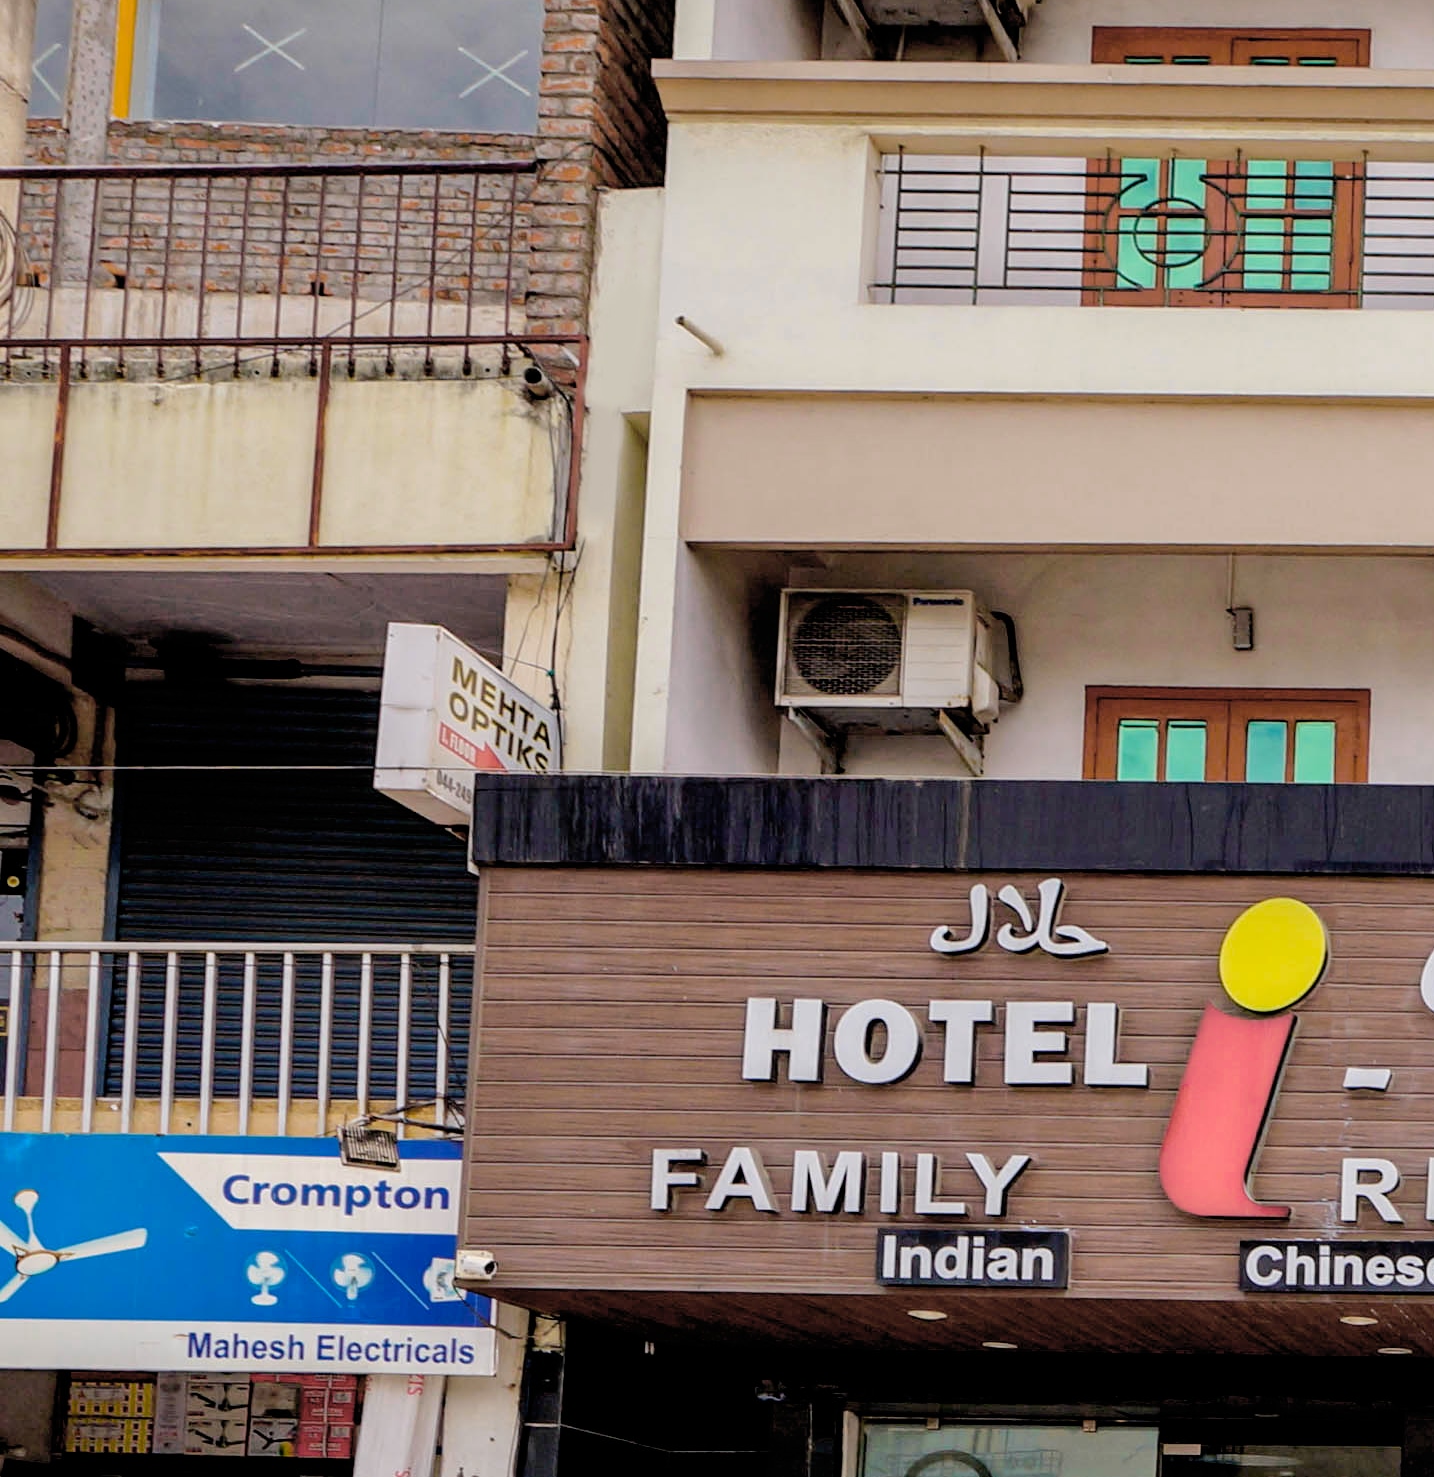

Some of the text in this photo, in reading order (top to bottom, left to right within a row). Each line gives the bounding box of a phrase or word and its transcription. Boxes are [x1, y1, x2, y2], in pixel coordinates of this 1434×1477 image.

[449, 691, 549, 773] OPTIKS
[452, 656, 551, 752] MEHTA
[929, 877, 1109, 956] حلال
[741, 996, 1149, 1087] HOTEL
[223, 1174, 450, 1216] Crompton
[649, 1146, 1032, 1216] FAMILY
[882, 1235, 1055, 1282] Indian
[187, 1331, 475, 1364] Mahesh Electricals
